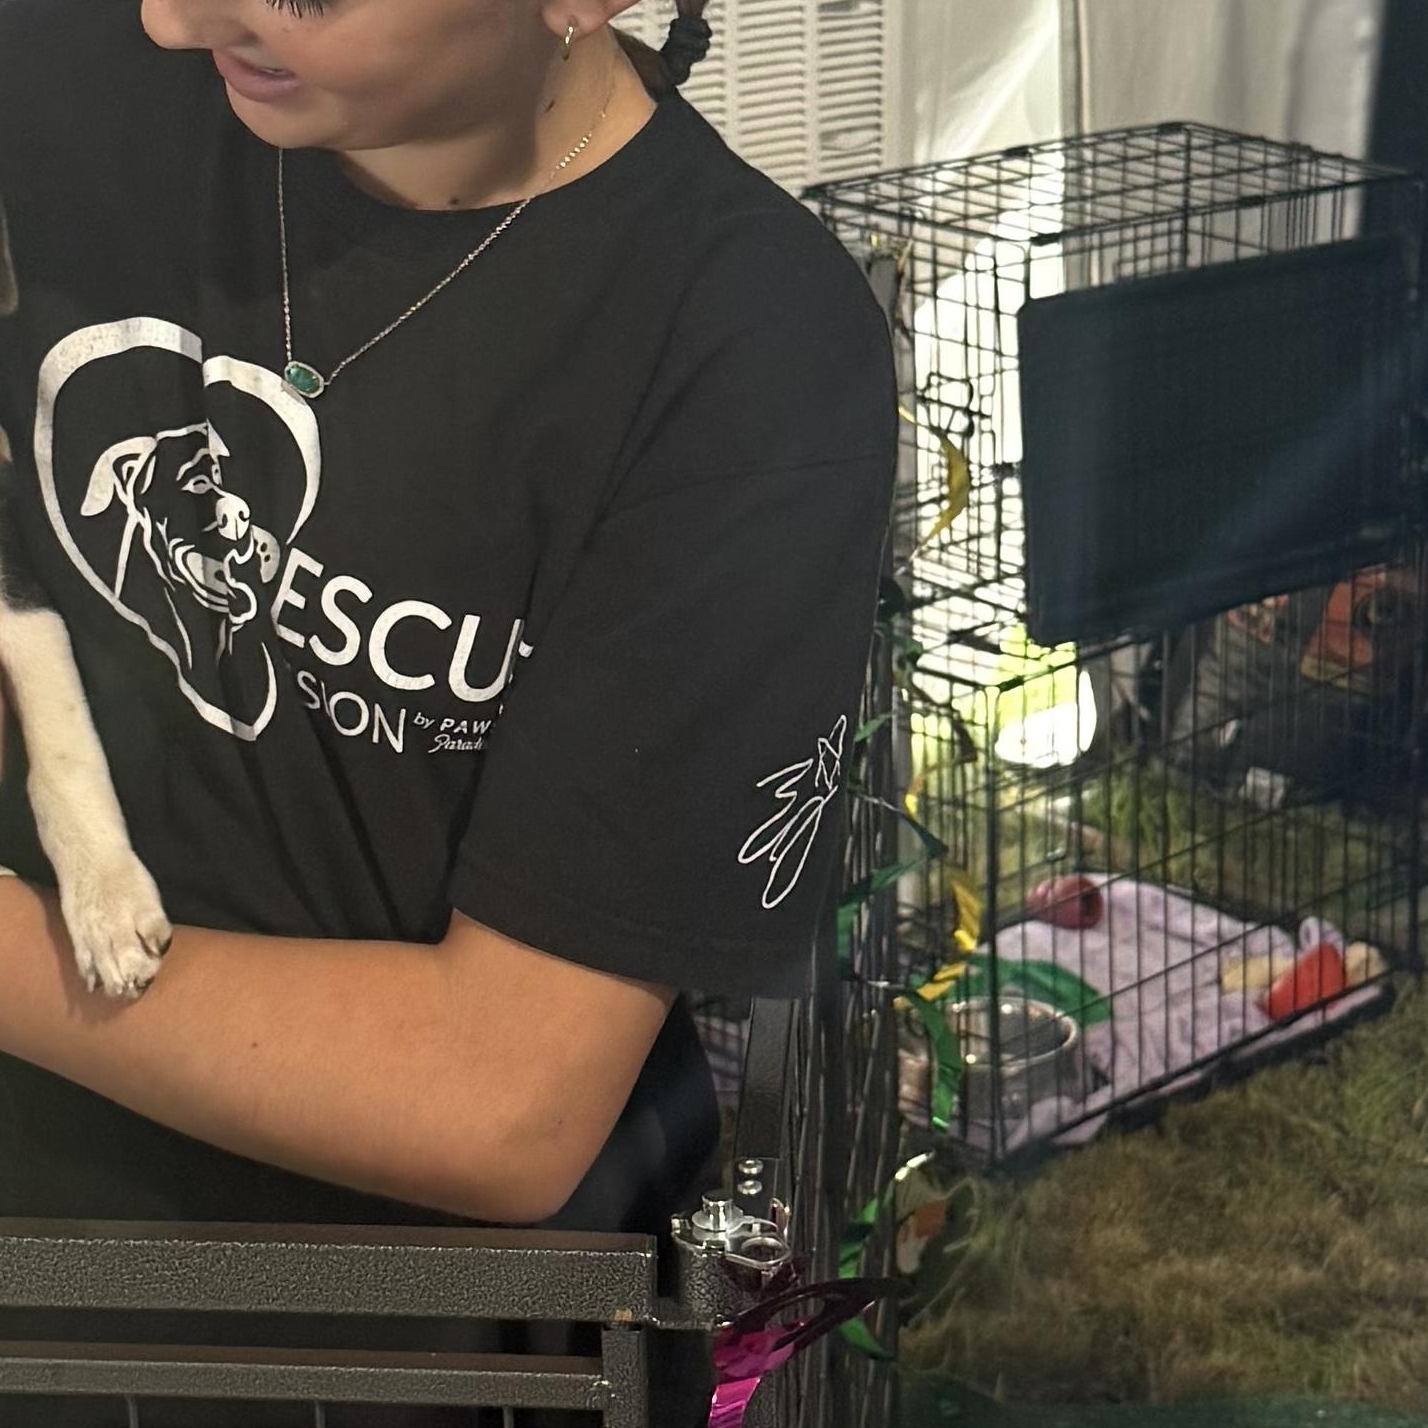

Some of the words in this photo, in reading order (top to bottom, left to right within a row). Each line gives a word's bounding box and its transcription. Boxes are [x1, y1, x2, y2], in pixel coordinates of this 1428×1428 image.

[270, 547, 534, 703] ESCU
[296, 669, 407, 754] SION
[413, 712, 436, 730] by
[439, 717, 493, 734] PAW
